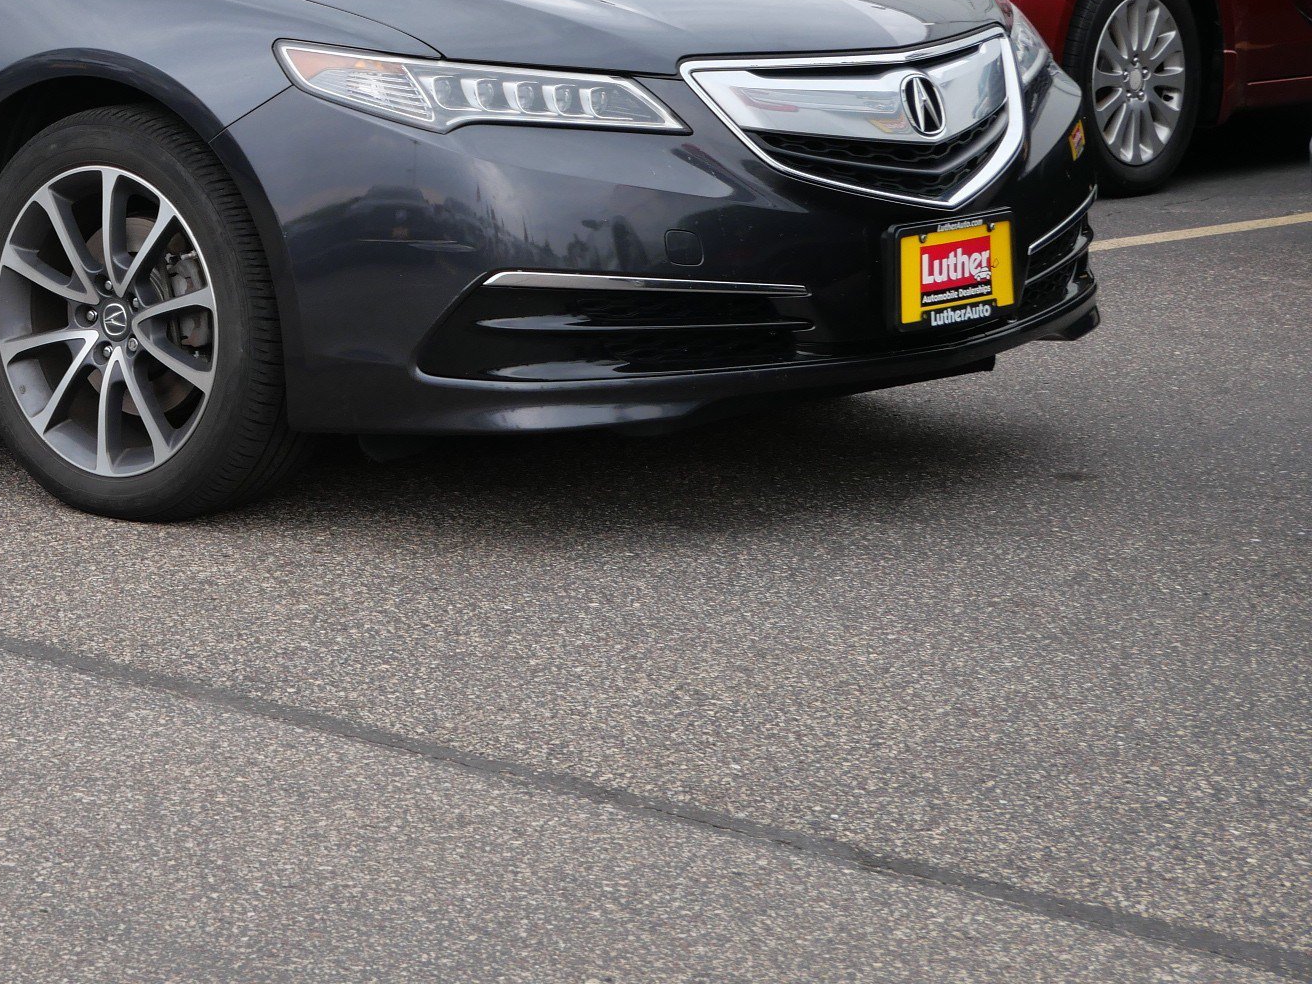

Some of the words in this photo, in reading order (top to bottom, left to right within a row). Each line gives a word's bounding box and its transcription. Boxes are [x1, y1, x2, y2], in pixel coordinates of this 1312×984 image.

[937, 219, 983, 232] LutherAuto.com
[921, 248, 990, 284] Luther
[922, 289, 958, 304] Automobile
[958, 284, 991, 297] Dealerships
[930, 303, 991, 326] LutherAuto
